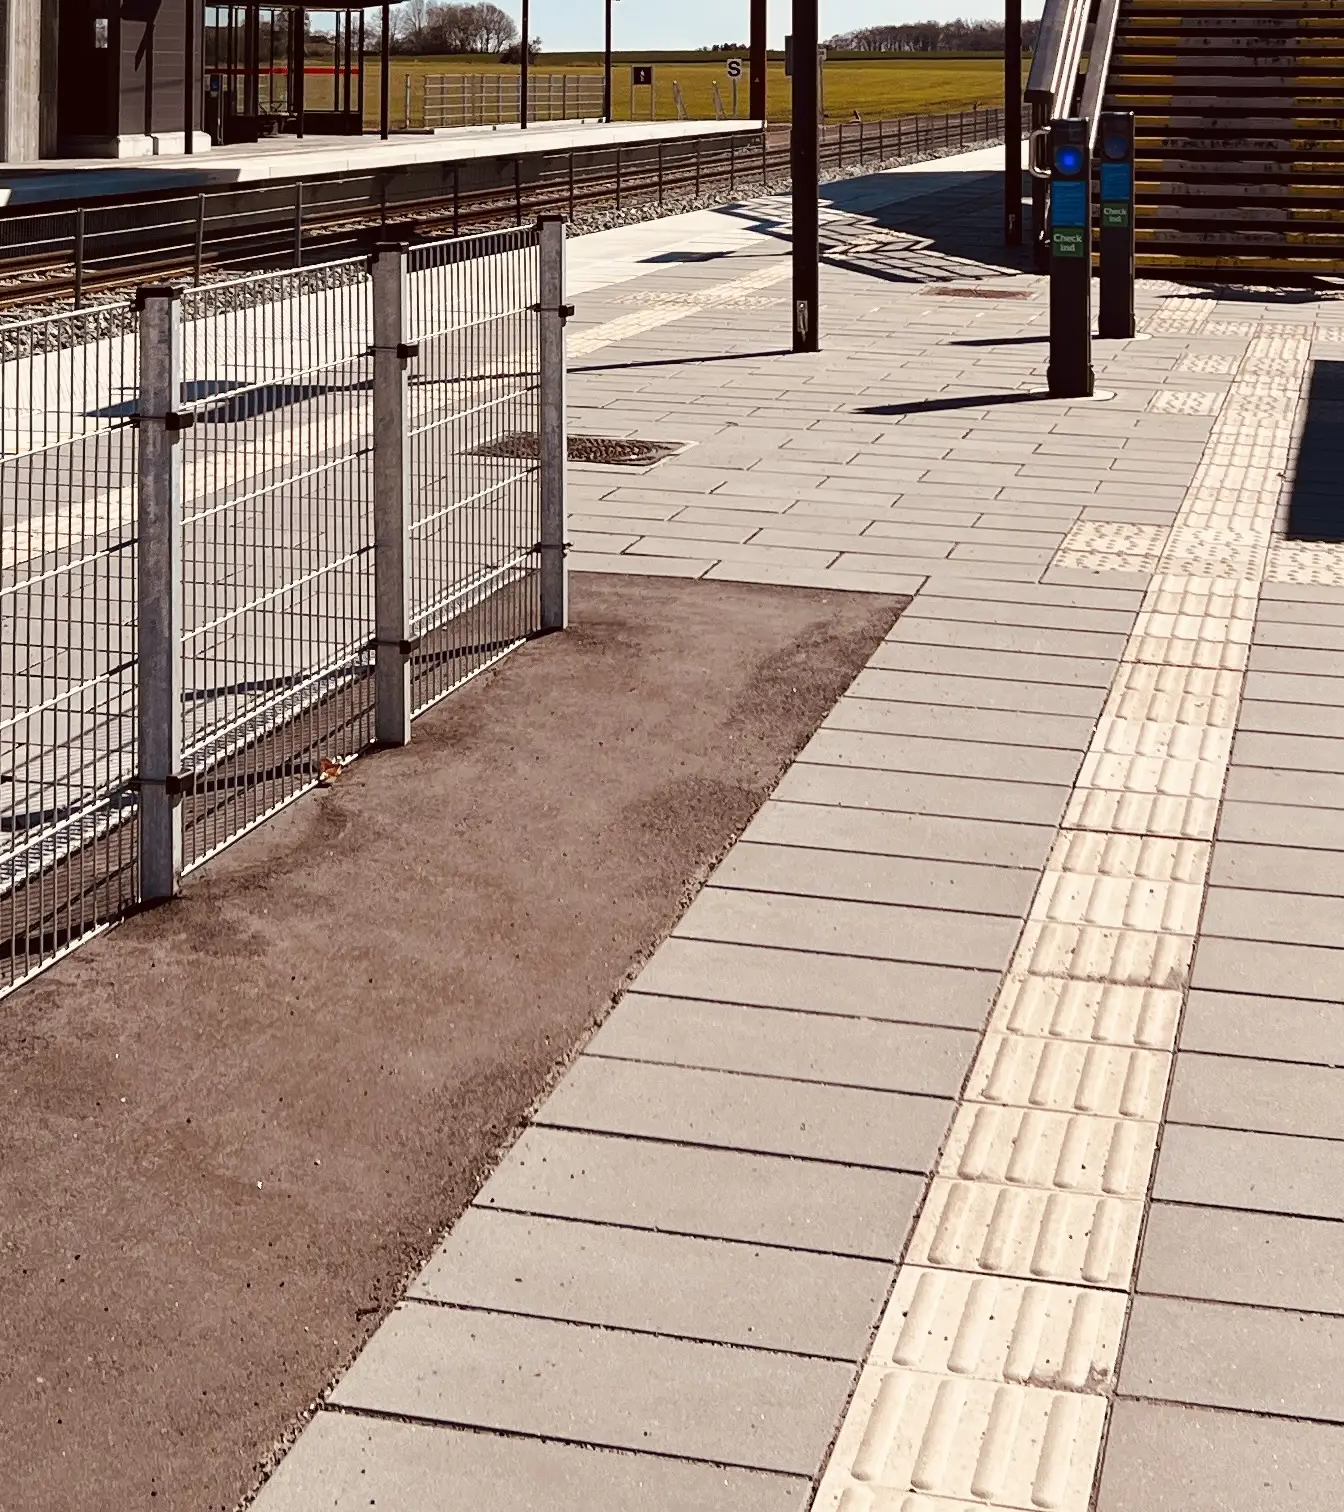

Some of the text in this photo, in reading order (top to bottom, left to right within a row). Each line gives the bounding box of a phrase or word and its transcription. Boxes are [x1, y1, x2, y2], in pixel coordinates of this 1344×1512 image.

[728, 61, 740, 77] S
[1103, 207, 1128, 216] Check
[1053, 233, 1083, 243] Check
[1060, 244, 1075, 252] ind
